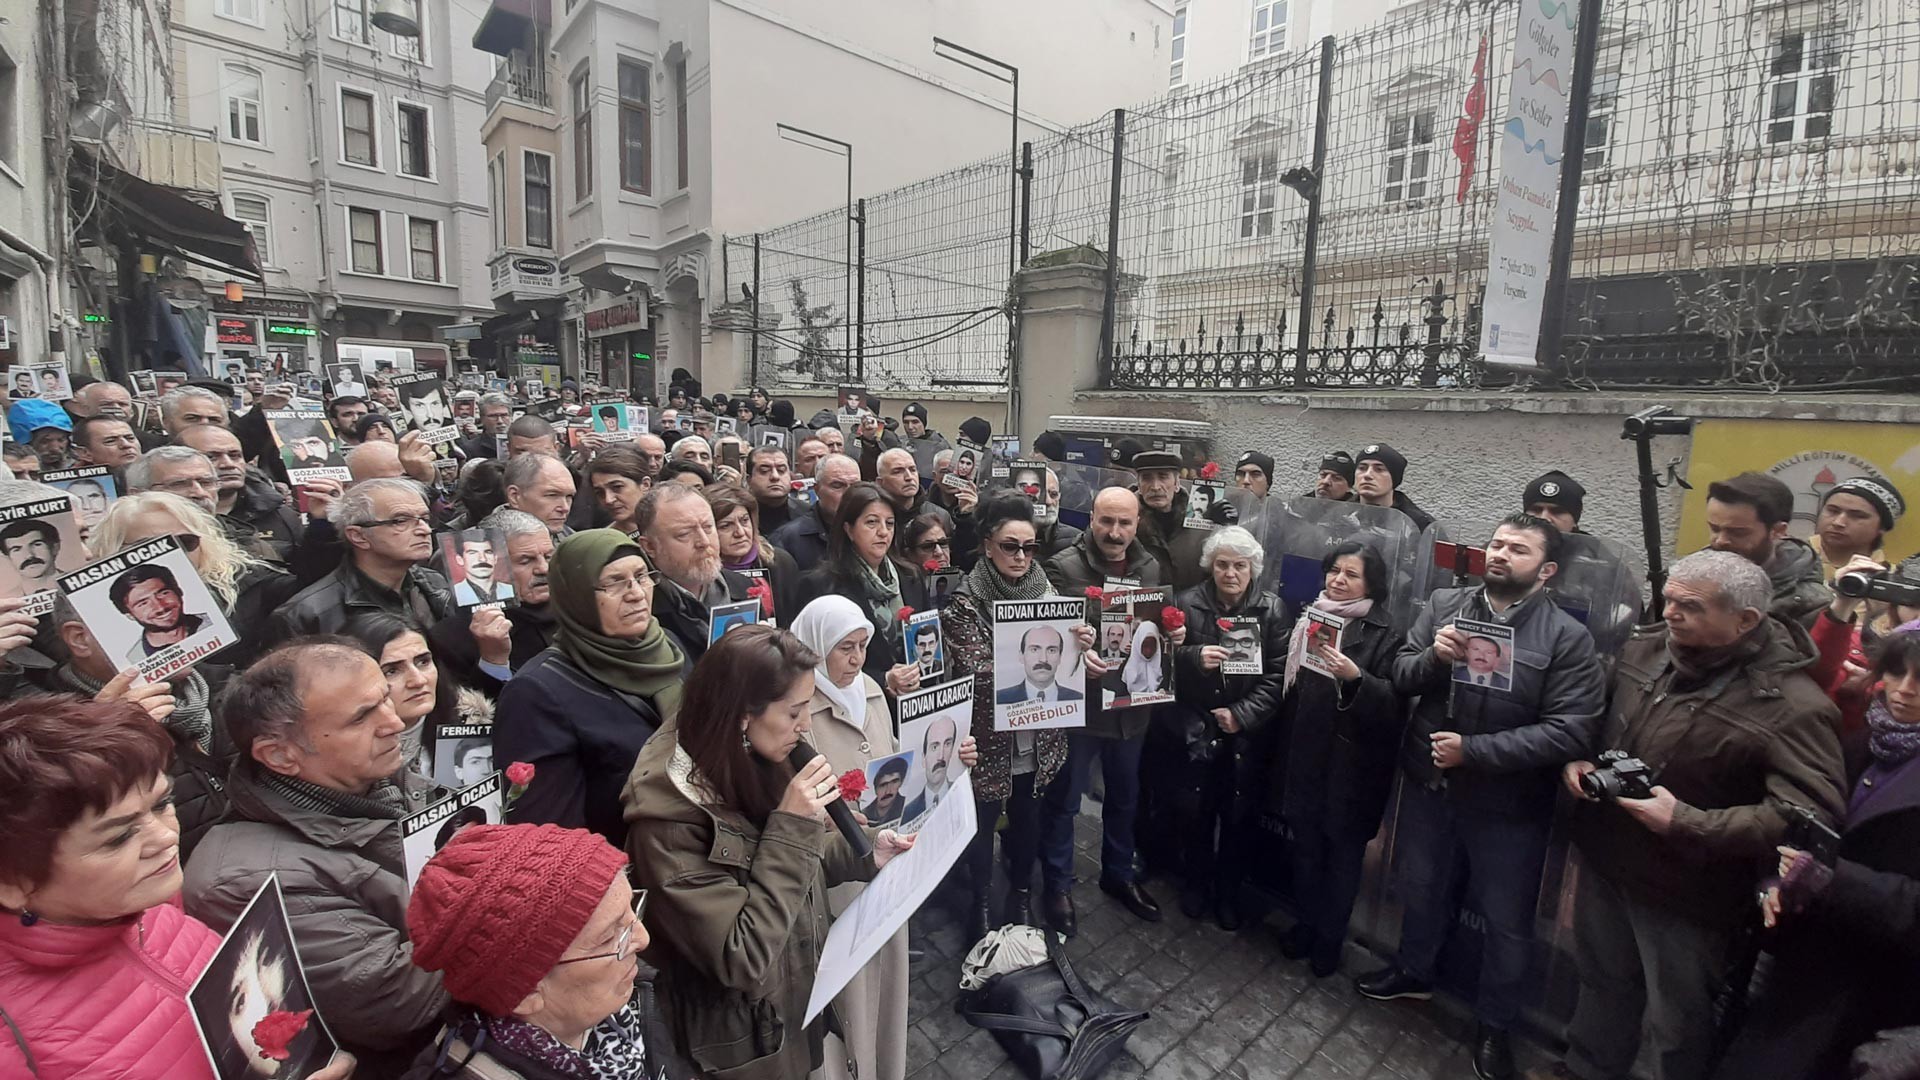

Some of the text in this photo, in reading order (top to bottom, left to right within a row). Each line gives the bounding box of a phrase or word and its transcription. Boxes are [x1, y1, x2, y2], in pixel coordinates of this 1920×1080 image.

[1528, 18, 1560, 58] Gölgeler
[1530, 98, 1552, 128] Sesler
[1507, 258, 1522, 276] Şubat
[1522, 263, 1536, 278] 2020
[1503, 282, 1527, 300] Perşembe
[216, 334, 253, 343] KUAFÖR
[392, 371, 438, 385] VEYSEL GÜNEY
[418, 426, 455, 439] ÖZALTINDA
[1771, 454, 1801, 474] MİLLİ
[1803, 451, 1846, 462] EĞİTİM
[44, 466, 108, 481] CEMAL BAYIR
[29, 500, 66, 515] KURT
[64, 538, 173, 591] HASAN OCAK
[1110, 592, 1163, 605] ASİYE KARAKOÇ
[998, 603, 1082, 620] RIDVAN KARAKOÇ
[140, 649, 185, 674] GÖZALTINDA
[144, 636, 222, 684] KAYBEDİLDİ
[902, 681, 972, 720] RIDVAN KARAKOÇ
[1007, 705, 1043, 717] GÖZALTINDA
[1009, 703, 1078, 728] KAYBEDİLDİ
[442, 726, 492, 736] FERHAT T
[407, 778, 496, 834] HASAN OCAK
